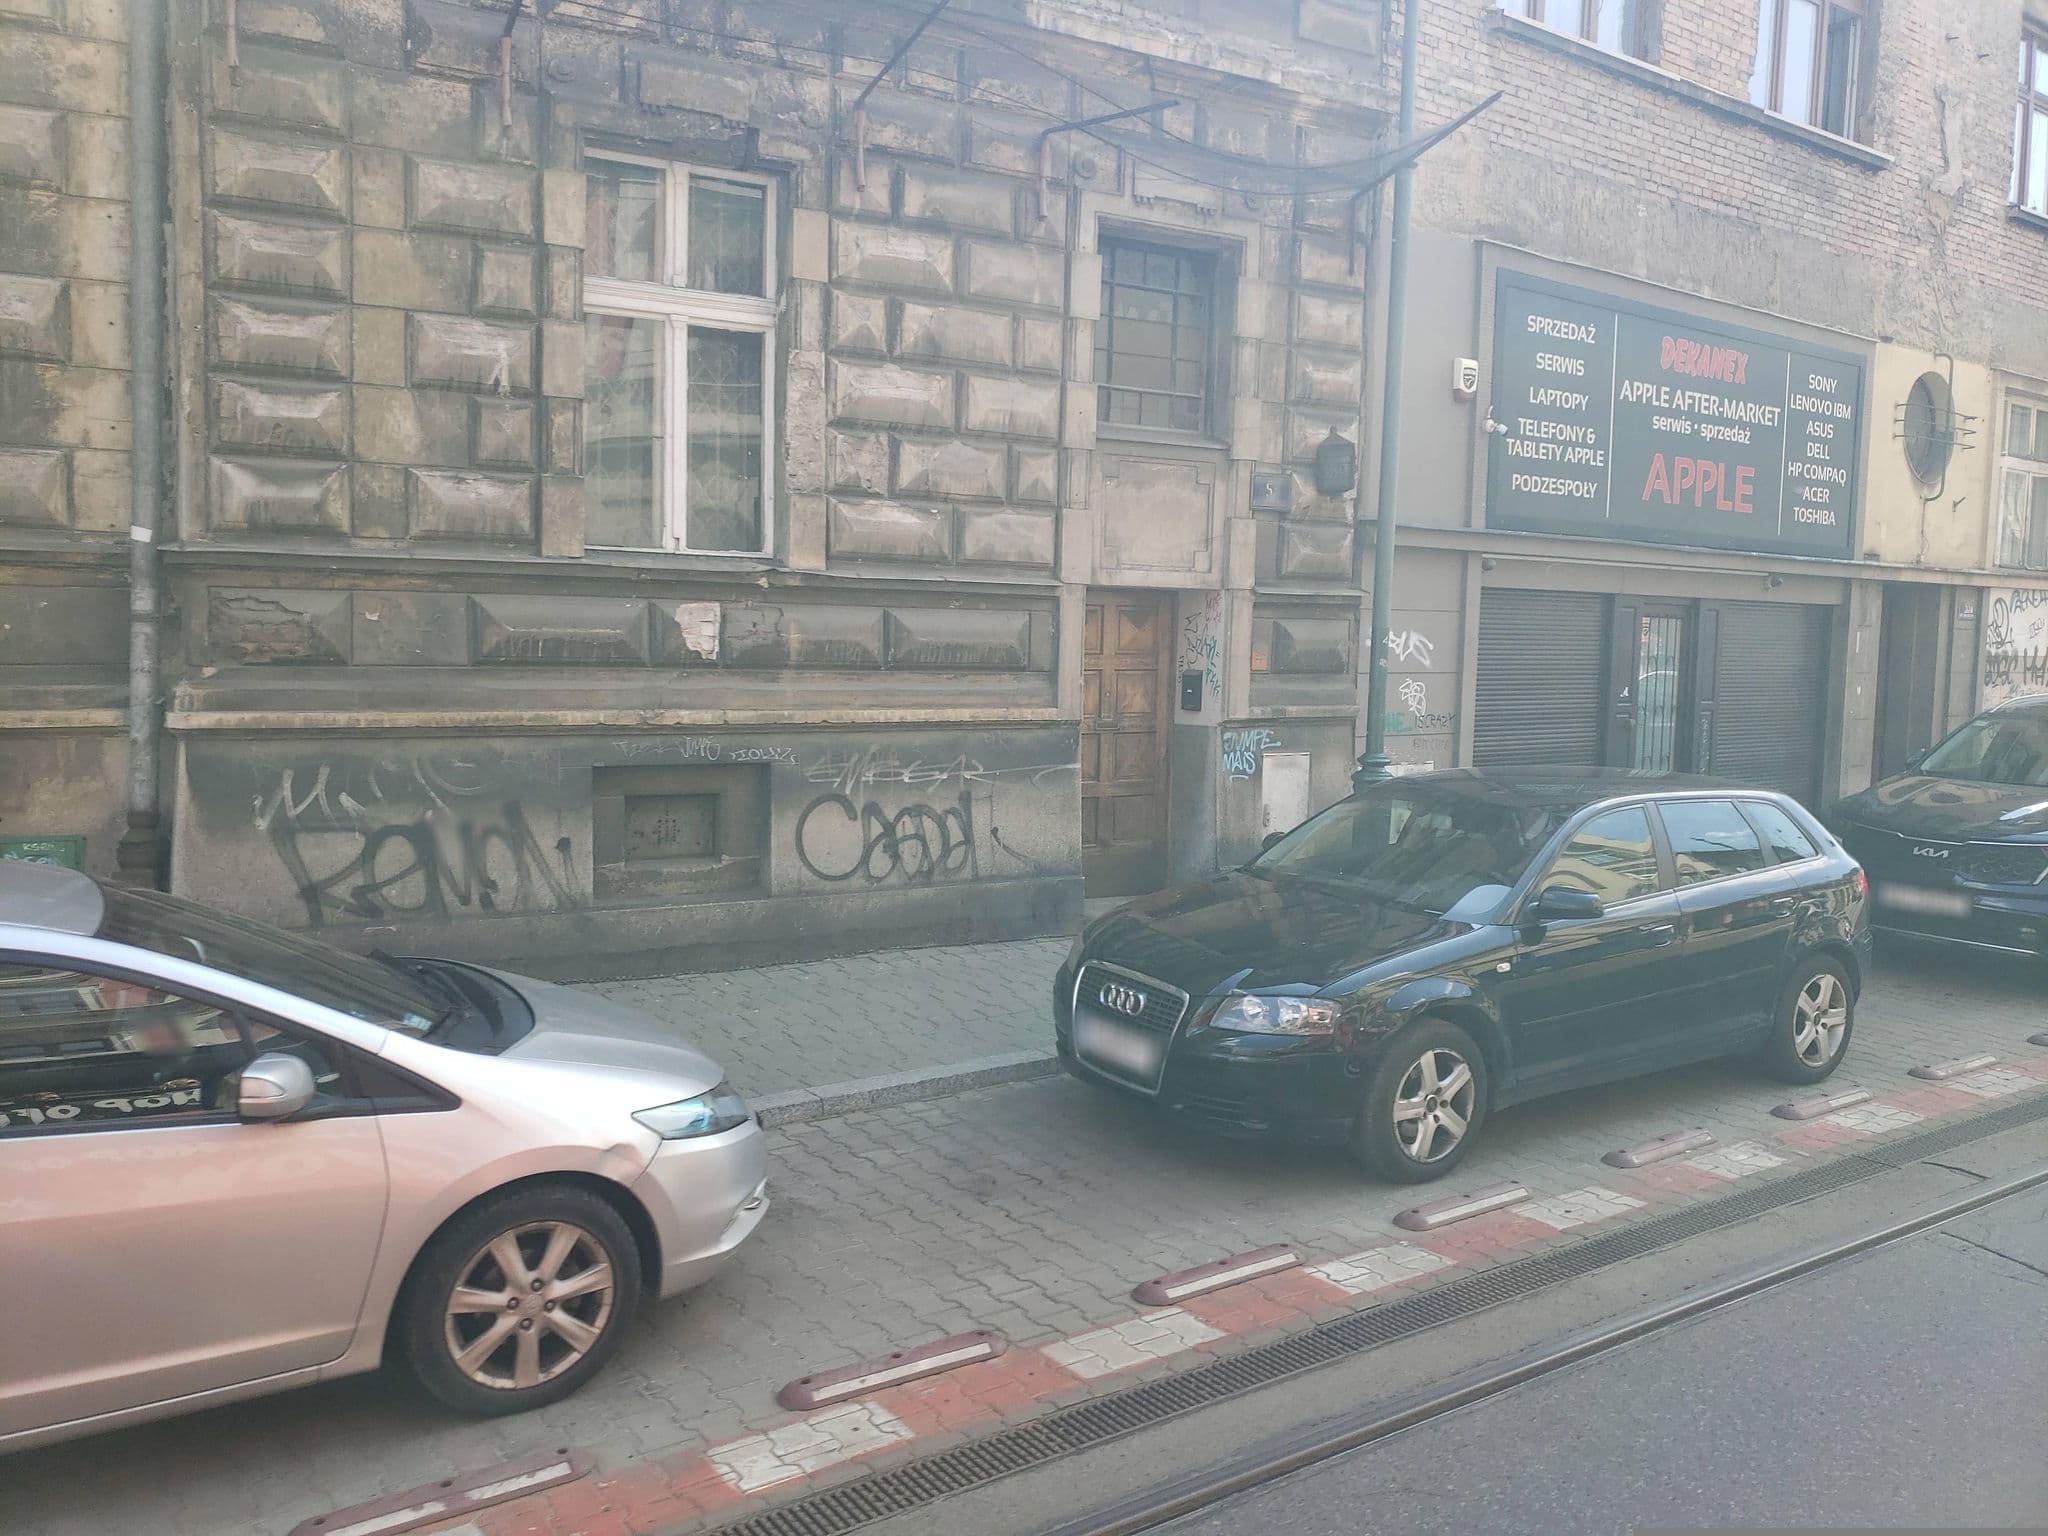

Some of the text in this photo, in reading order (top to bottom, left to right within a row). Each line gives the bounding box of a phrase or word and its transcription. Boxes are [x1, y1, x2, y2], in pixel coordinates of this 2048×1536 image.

[1527, 314, 1596, 344] SPRZEDAŻ
[1536, 352, 1585, 377] SERWIS
[1660, 336, 1749, 385] DEKANEX
[1808, 374, 1838, 394] SONY
[1529, 386, 1590, 412] LAPTOPY
[1620, 379, 1781, 427] APPLE AFTER-MARKET
[1790, 393, 1852, 420] LENOVO IBM
[1518, 417, 1596, 444] TELEFONY &
[1652, 415, 1751, 445] serwis sprzedaż
[1806, 420, 1834, 439] ASUS
[1506, 438, 1605, 467] TABLETY APPLE
[1806, 441, 1831, 460] DELL
[1512, 473, 1598, 499] PODZESPOŁY
[1642, 452, 1756, 514] APPLE
[1788, 461, 1847, 487] HP COMPAQ
[1802, 486, 1830, 504] ACER
[1793, 506, 1836, 526] TOSHIBA
